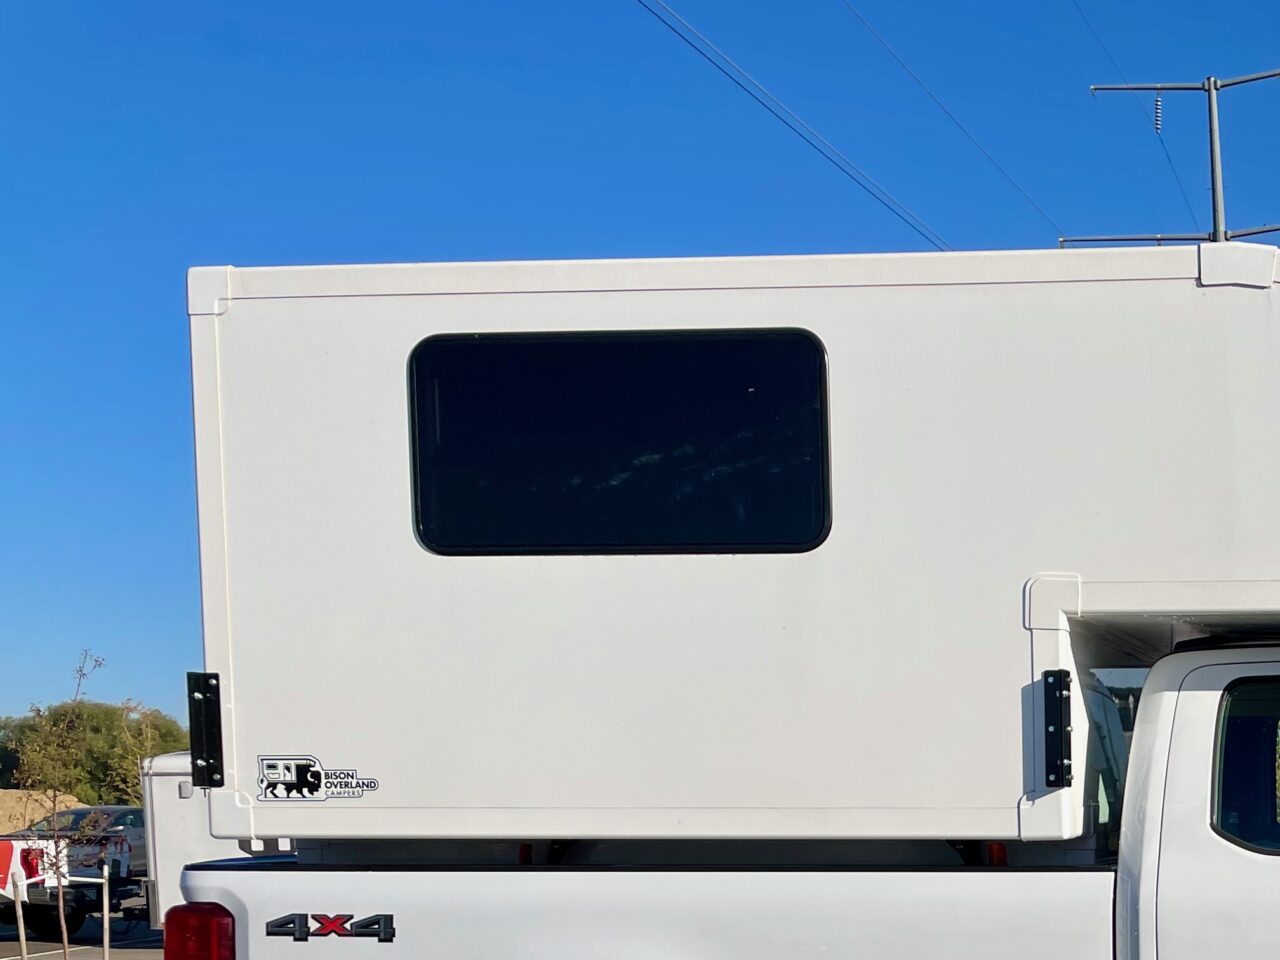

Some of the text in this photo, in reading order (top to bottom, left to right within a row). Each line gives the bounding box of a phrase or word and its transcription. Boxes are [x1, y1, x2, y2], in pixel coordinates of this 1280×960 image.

[324, 771, 355, 780] BISON
[324, 780, 376, 789] OVERLAND
[324, 789, 361, 797] CAMPERS
